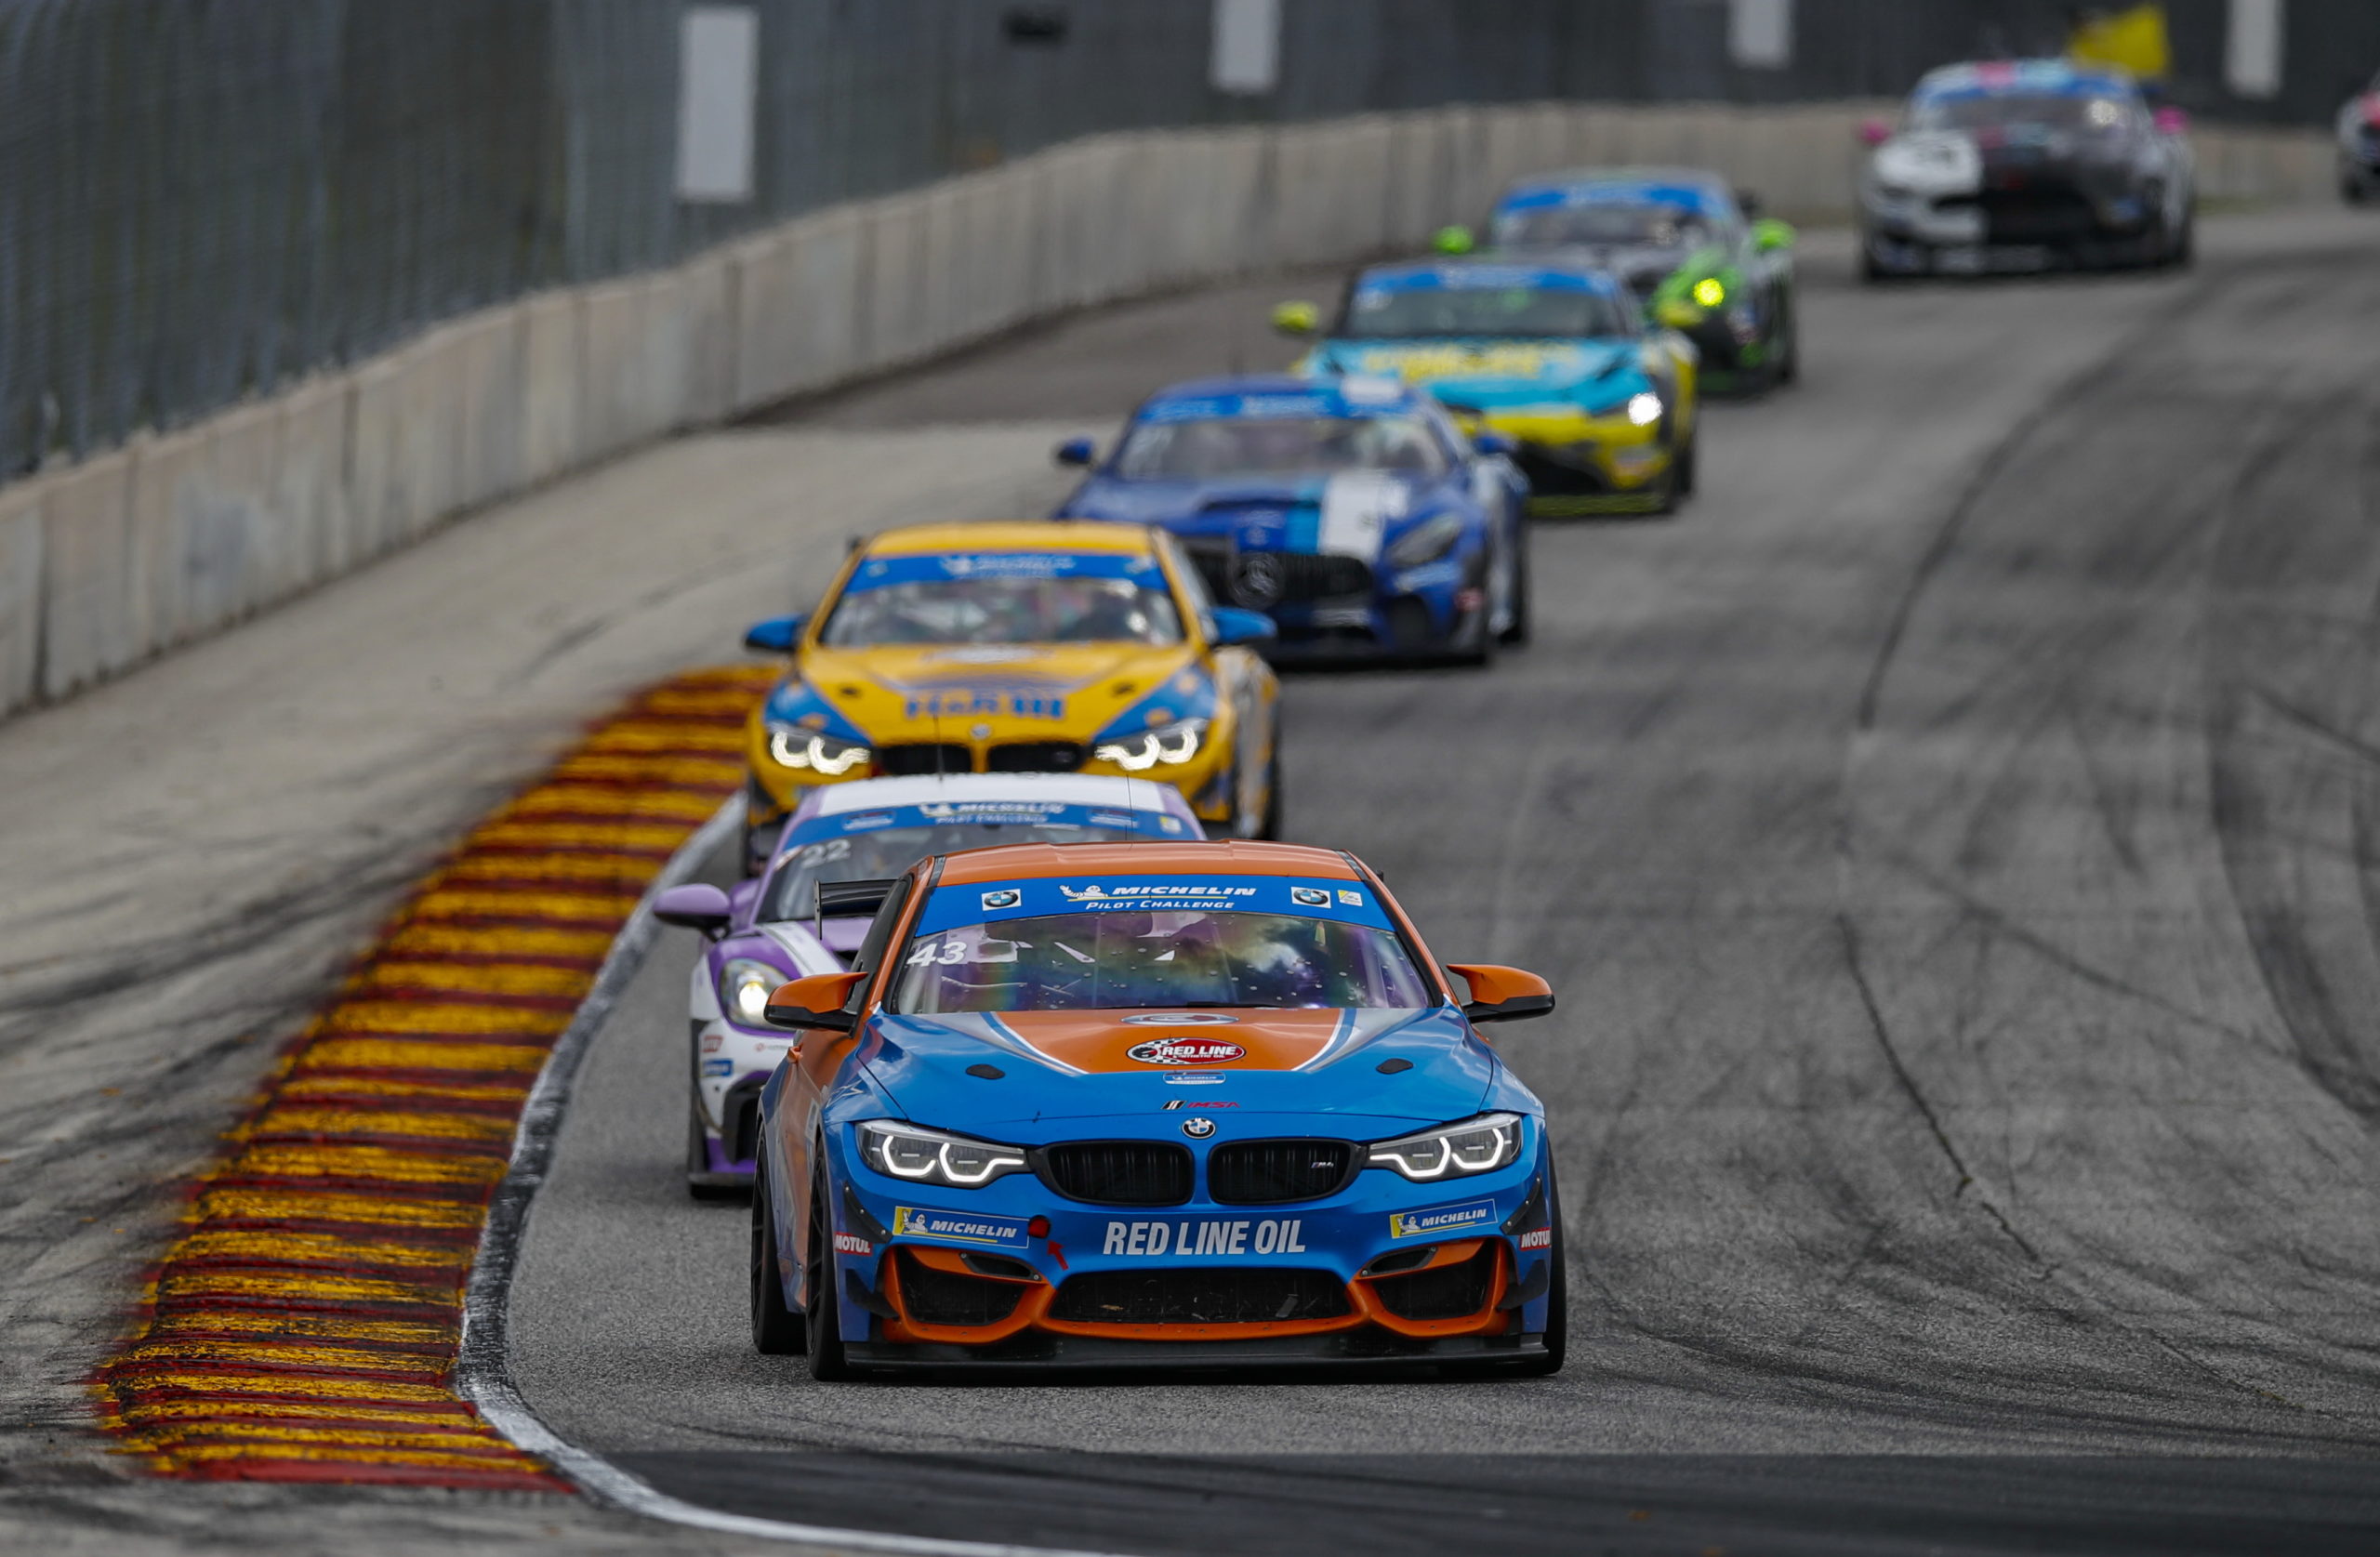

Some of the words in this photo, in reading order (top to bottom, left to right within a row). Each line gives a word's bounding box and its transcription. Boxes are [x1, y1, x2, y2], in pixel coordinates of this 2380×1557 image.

[801, 839, 852, 868] 22
[1112, 886, 1257, 896] MICHELIN
[1086, 902, 1135, 910] PILOT
[1140, 900, 1235, 909] CHALLENGE
[906, 941, 968, 967] 43
[1162, 1046, 1197, 1056] RED
[1199, 1046, 1237, 1056] LINE
[1421, 1208, 1487, 1227] MICHELIN
[930, 1220, 1017, 1238] MICHELIN
[1103, 1221, 1170, 1256] RED
[1175, 1221, 1250, 1255] LINE
[1254, 1220, 1306, 1255] OIL
[834, 1234, 871, 1253] MOTUL
[1521, 1231, 1551, 1248] MOTU
